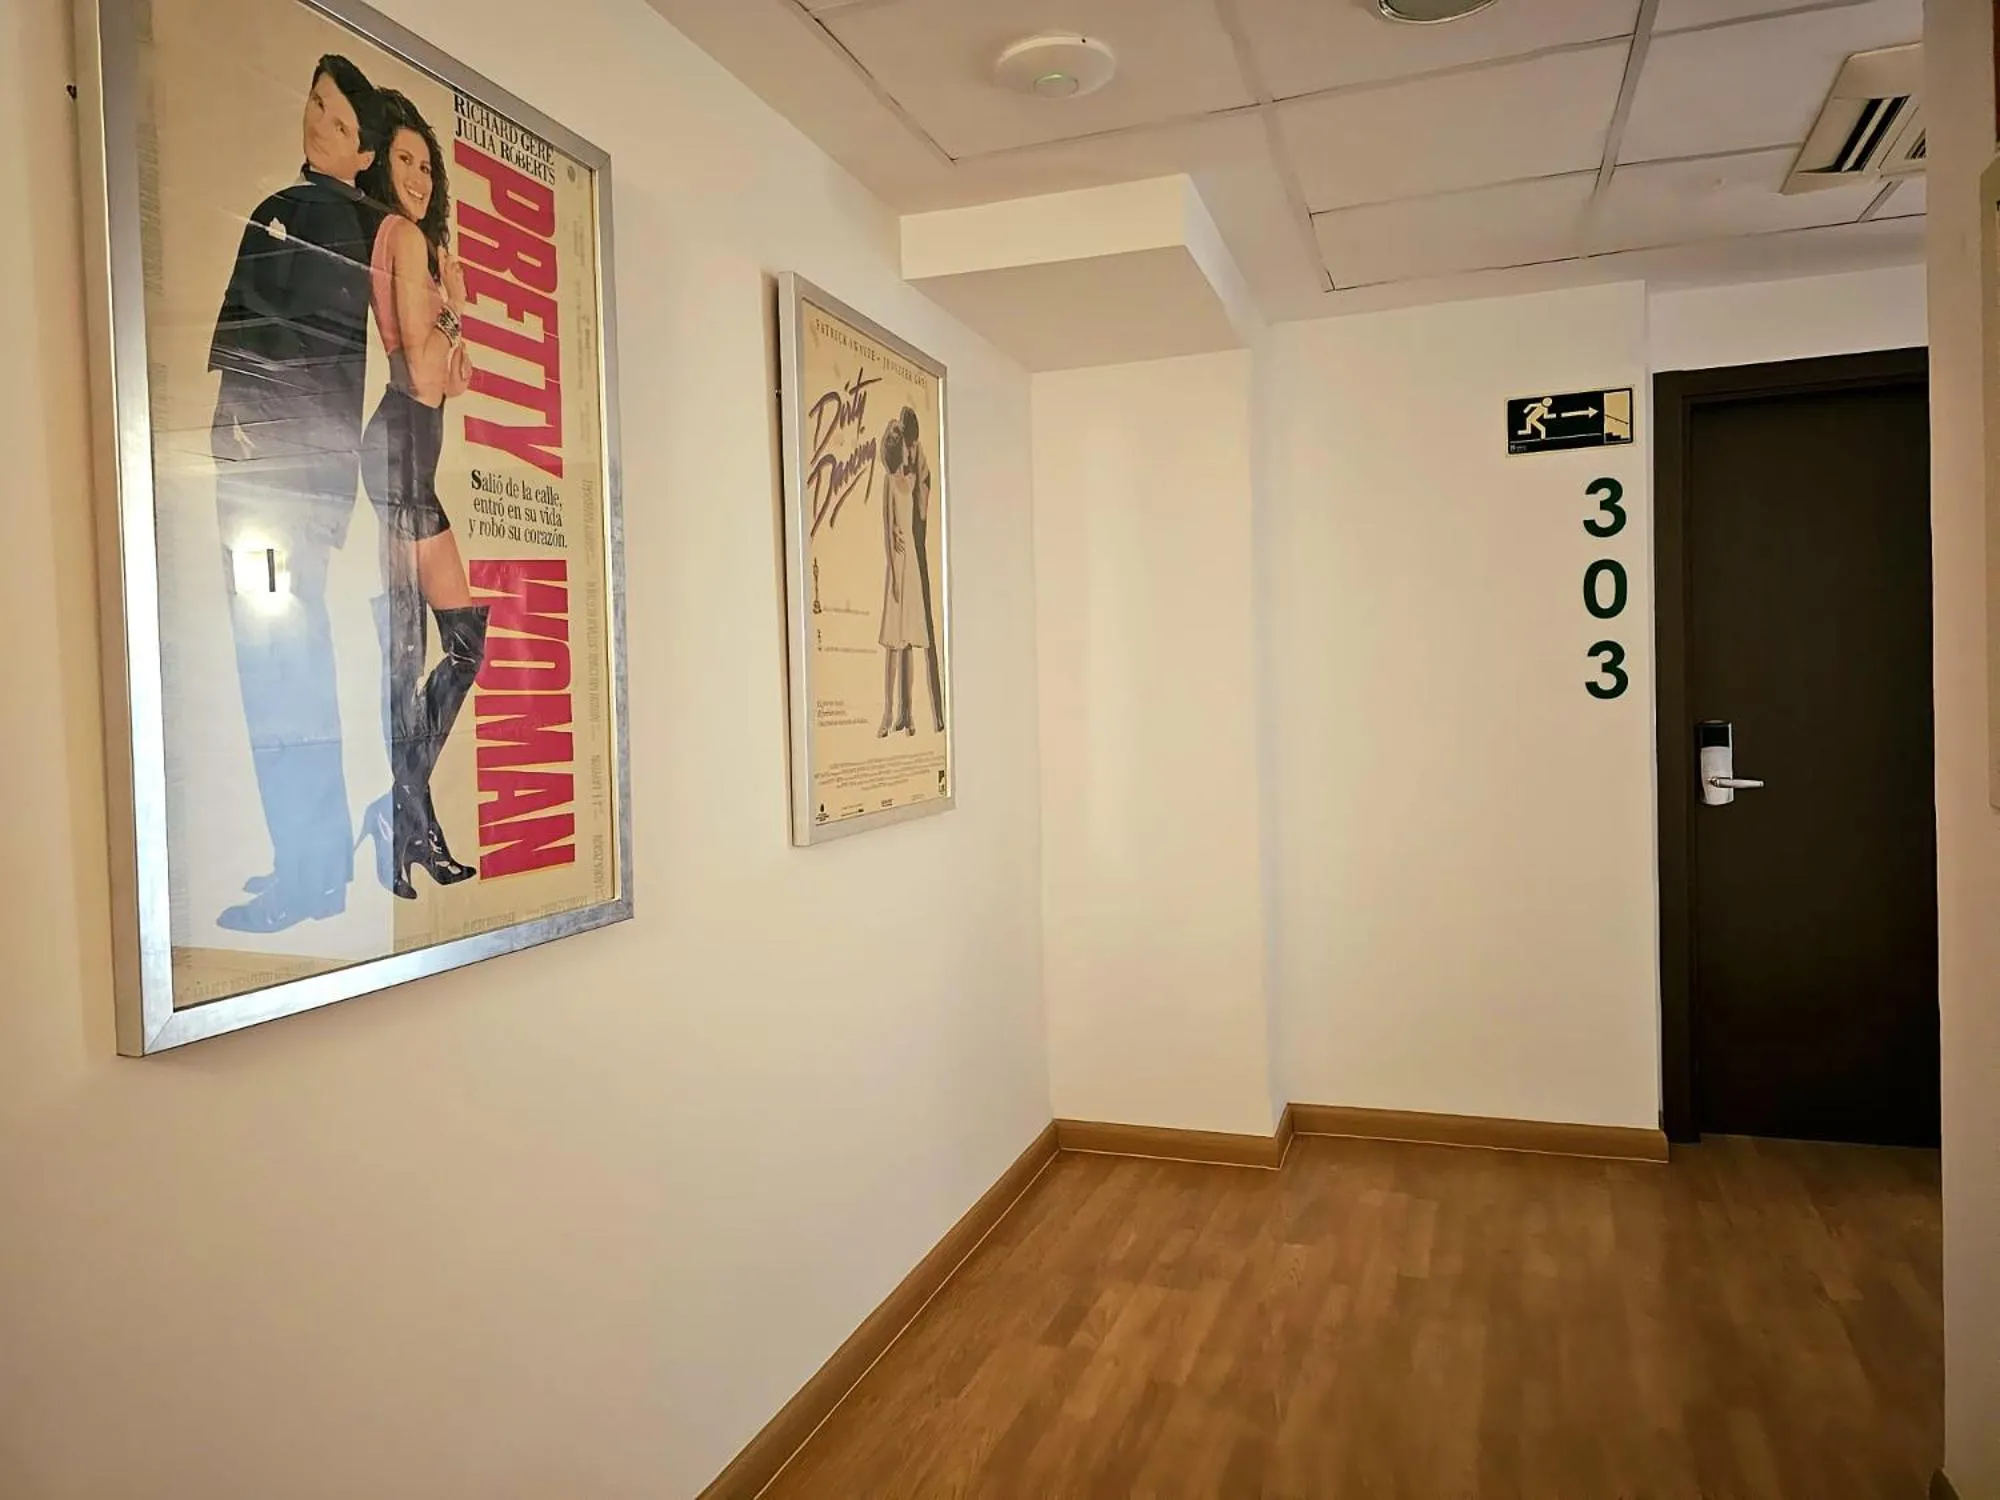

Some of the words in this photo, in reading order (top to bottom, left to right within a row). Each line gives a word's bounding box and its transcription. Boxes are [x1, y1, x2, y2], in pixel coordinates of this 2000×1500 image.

[454, 94, 518, 145] RICHARD
[520, 133, 554, 166] GERE
[455, 116, 496, 154] JULIA
[500, 140, 556, 186] ROBERTS
[454, 139, 564, 479] PRETTY
[809, 367, 882, 465] Dirty
[471, 469, 503, 495] Salió
[505, 477, 520, 498] de
[522, 480, 532, 500] la
[535, 485, 562, 511] calle,
[473, 497, 505, 517] entró
[507, 504, 521, 521] en
[524, 507, 537, 522] su
[540, 506, 562, 527] vida
[806, 437, 876, 539] Dancing
[468, 518, 475, 538] y
[479, 517, 505, 539] robó
[508, 525, 521, 541] su
[524, 528, 567, 548] corazón.
[469, 559, 576, 880] WOMAN
